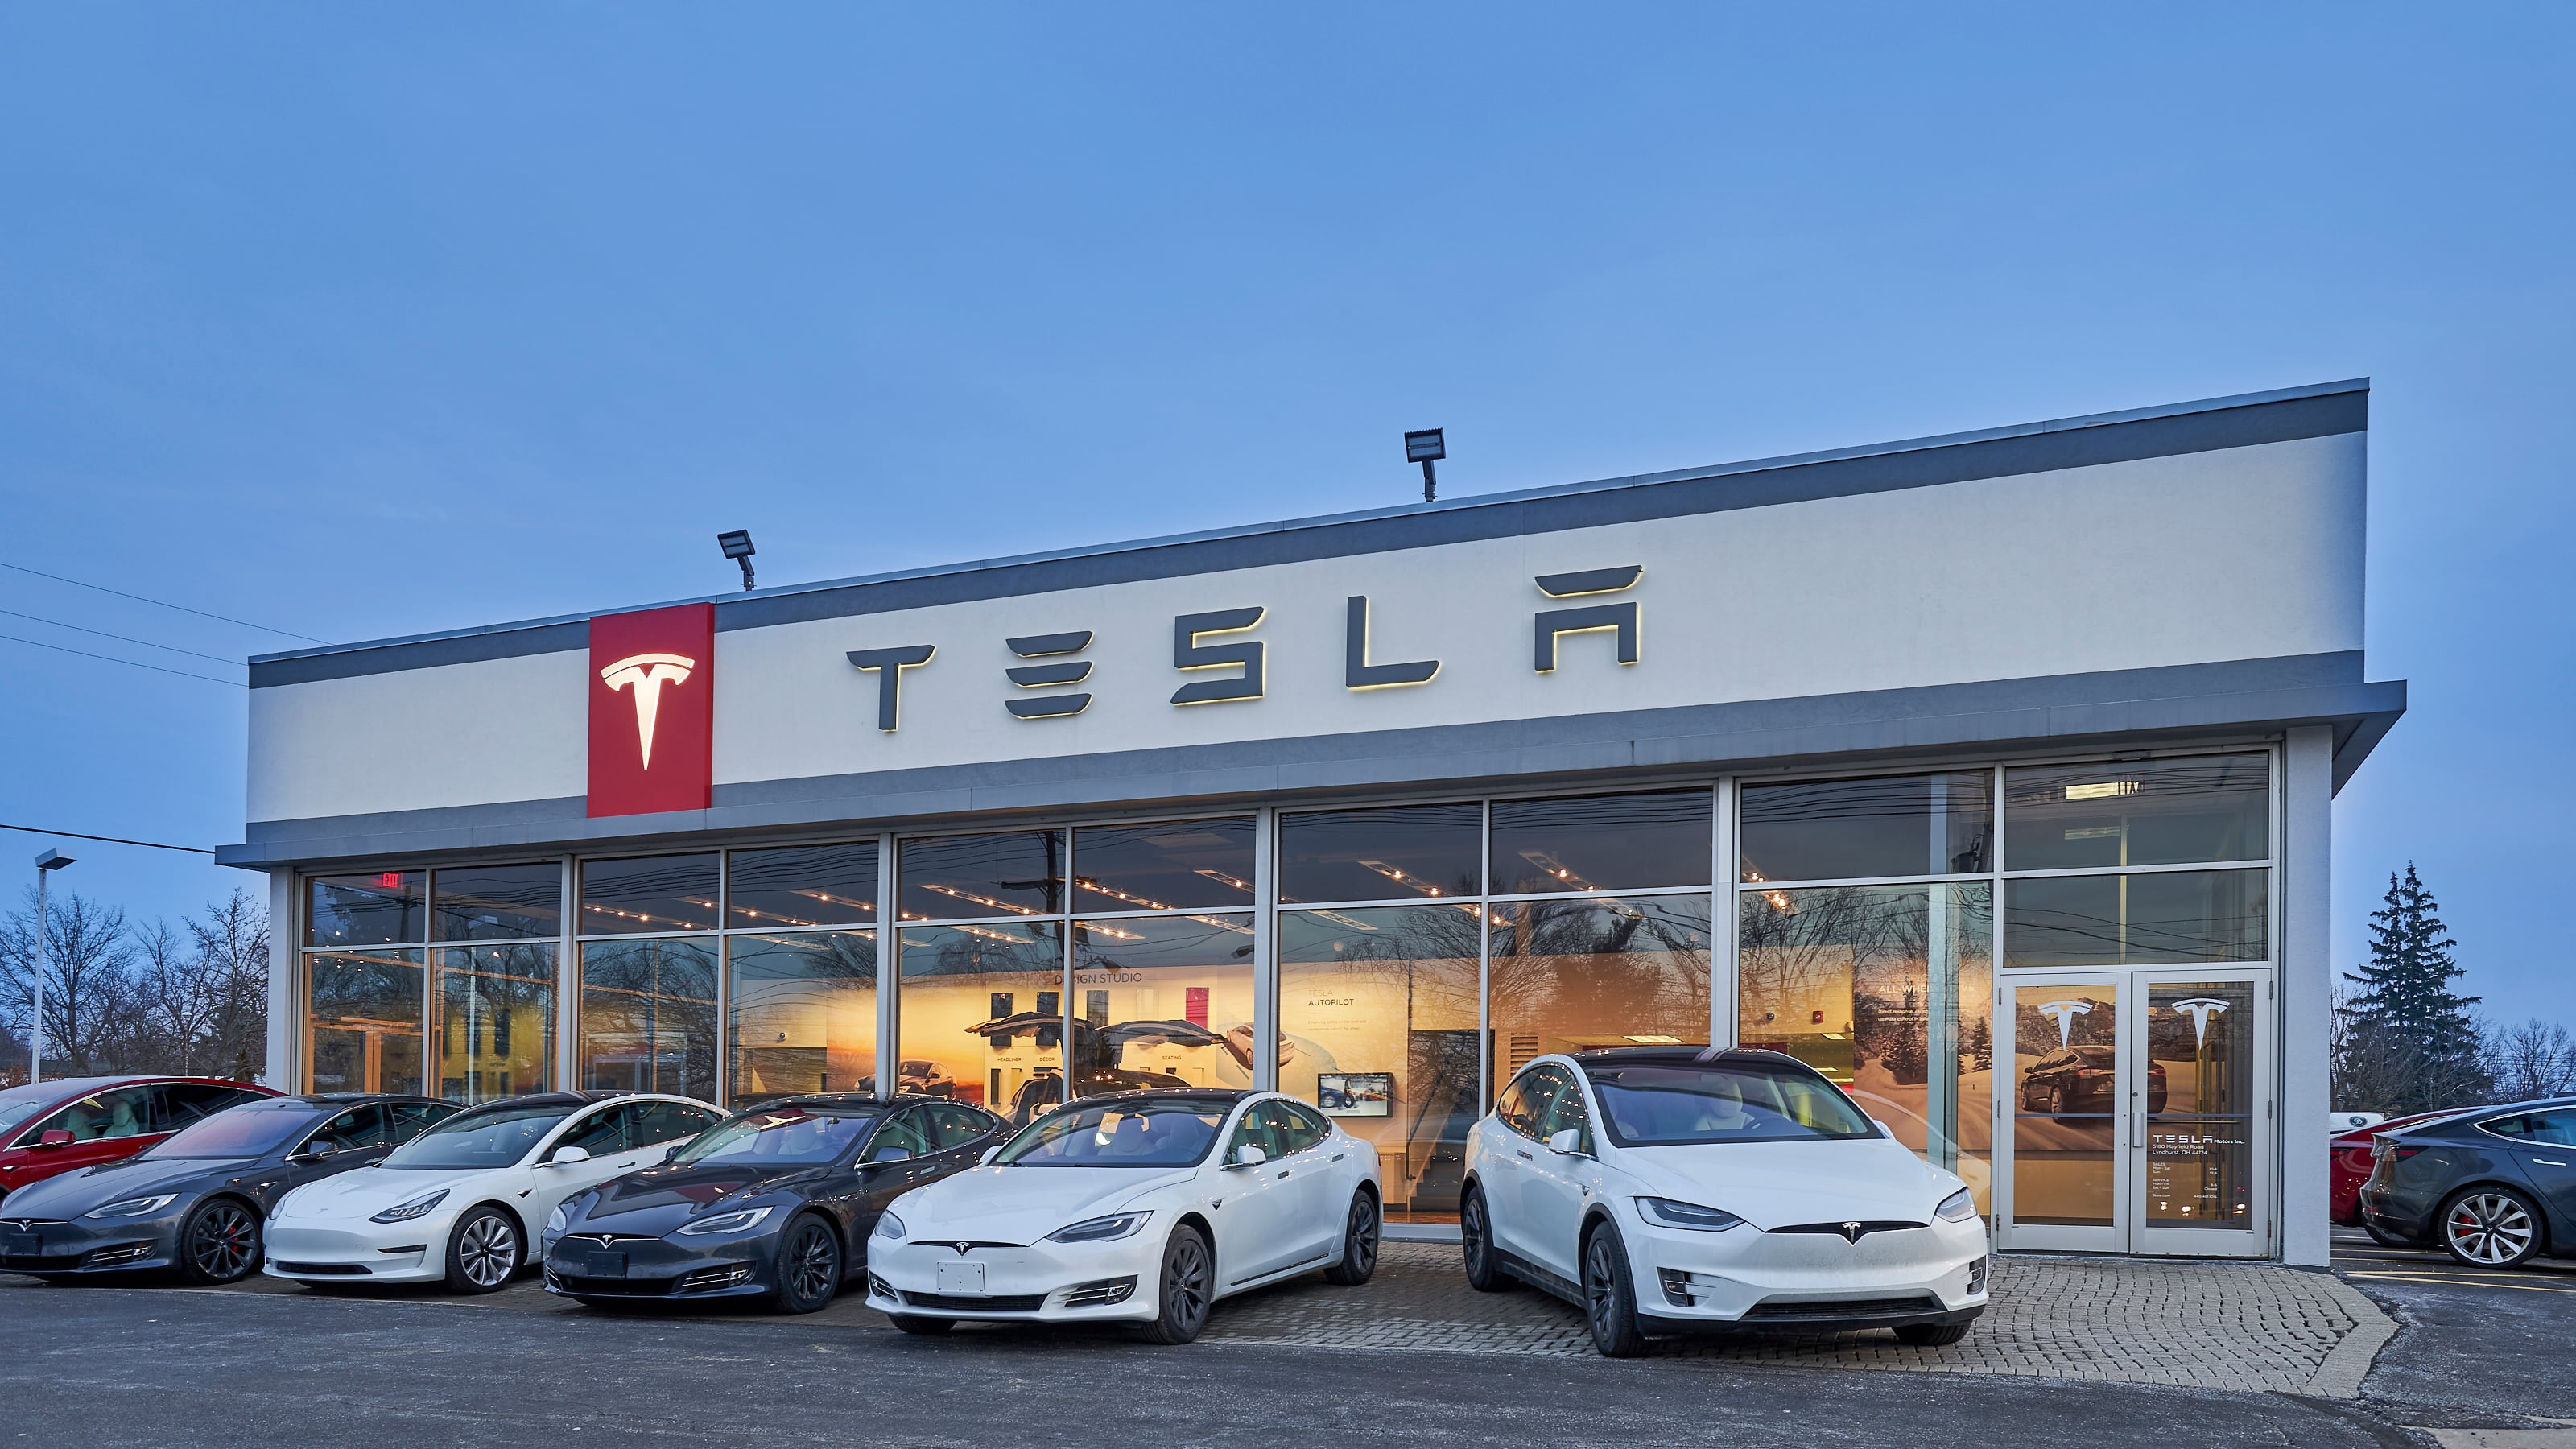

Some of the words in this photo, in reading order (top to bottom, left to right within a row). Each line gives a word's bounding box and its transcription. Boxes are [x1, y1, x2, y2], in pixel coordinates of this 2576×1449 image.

[846, 565, 1642, 733] TESLA
[383, 873, 399, 888] EXIT
[1100, 972, 1142, 984] STUDIO
[1308, 998, 1354, 1006] AUTOPILOT
[2153, 1134, 2213, 1143] TESLA
